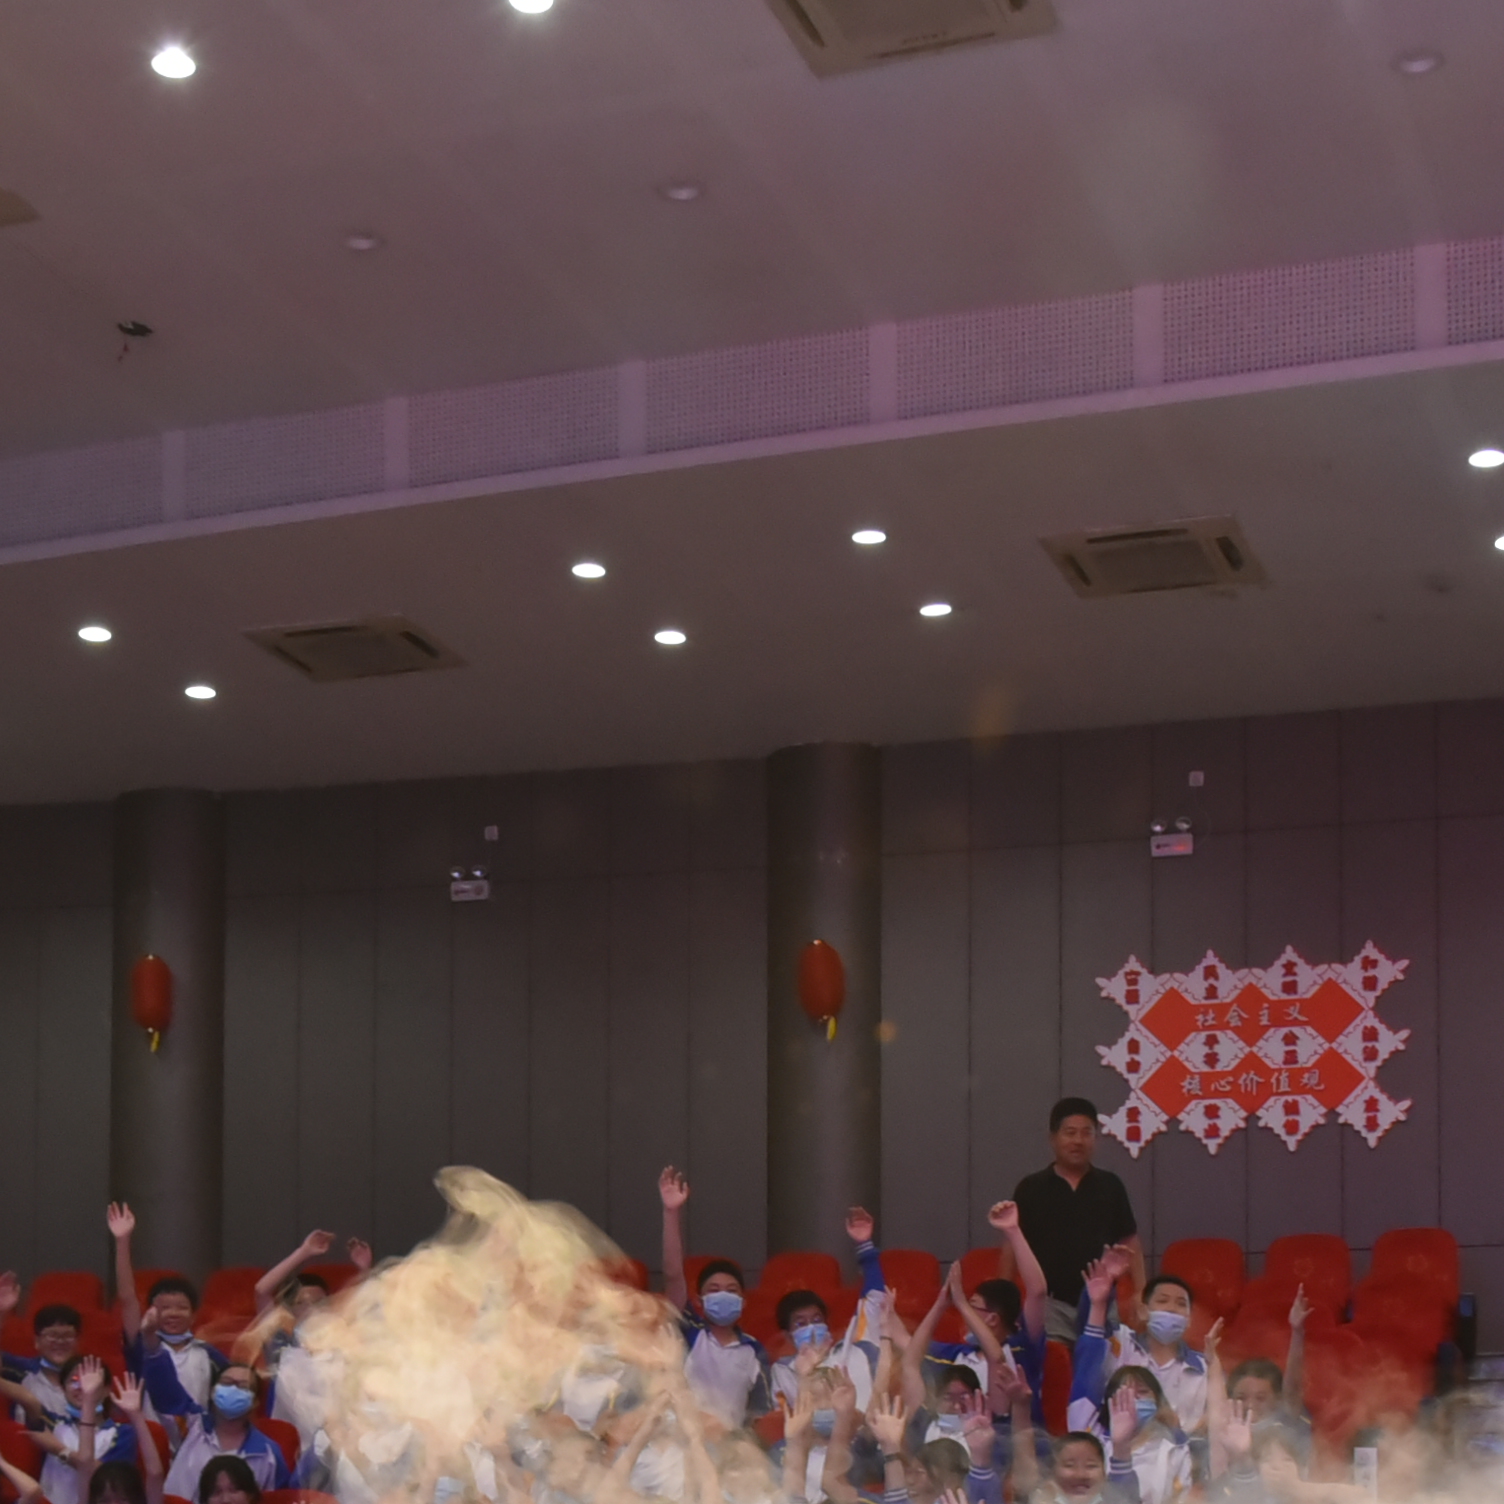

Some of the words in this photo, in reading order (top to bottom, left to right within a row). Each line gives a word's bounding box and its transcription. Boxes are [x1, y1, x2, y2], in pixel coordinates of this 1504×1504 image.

[1195, 1003, 1309, 1028] 社会主义
[1180, 1071, 1326, 1097] 核心价值观
